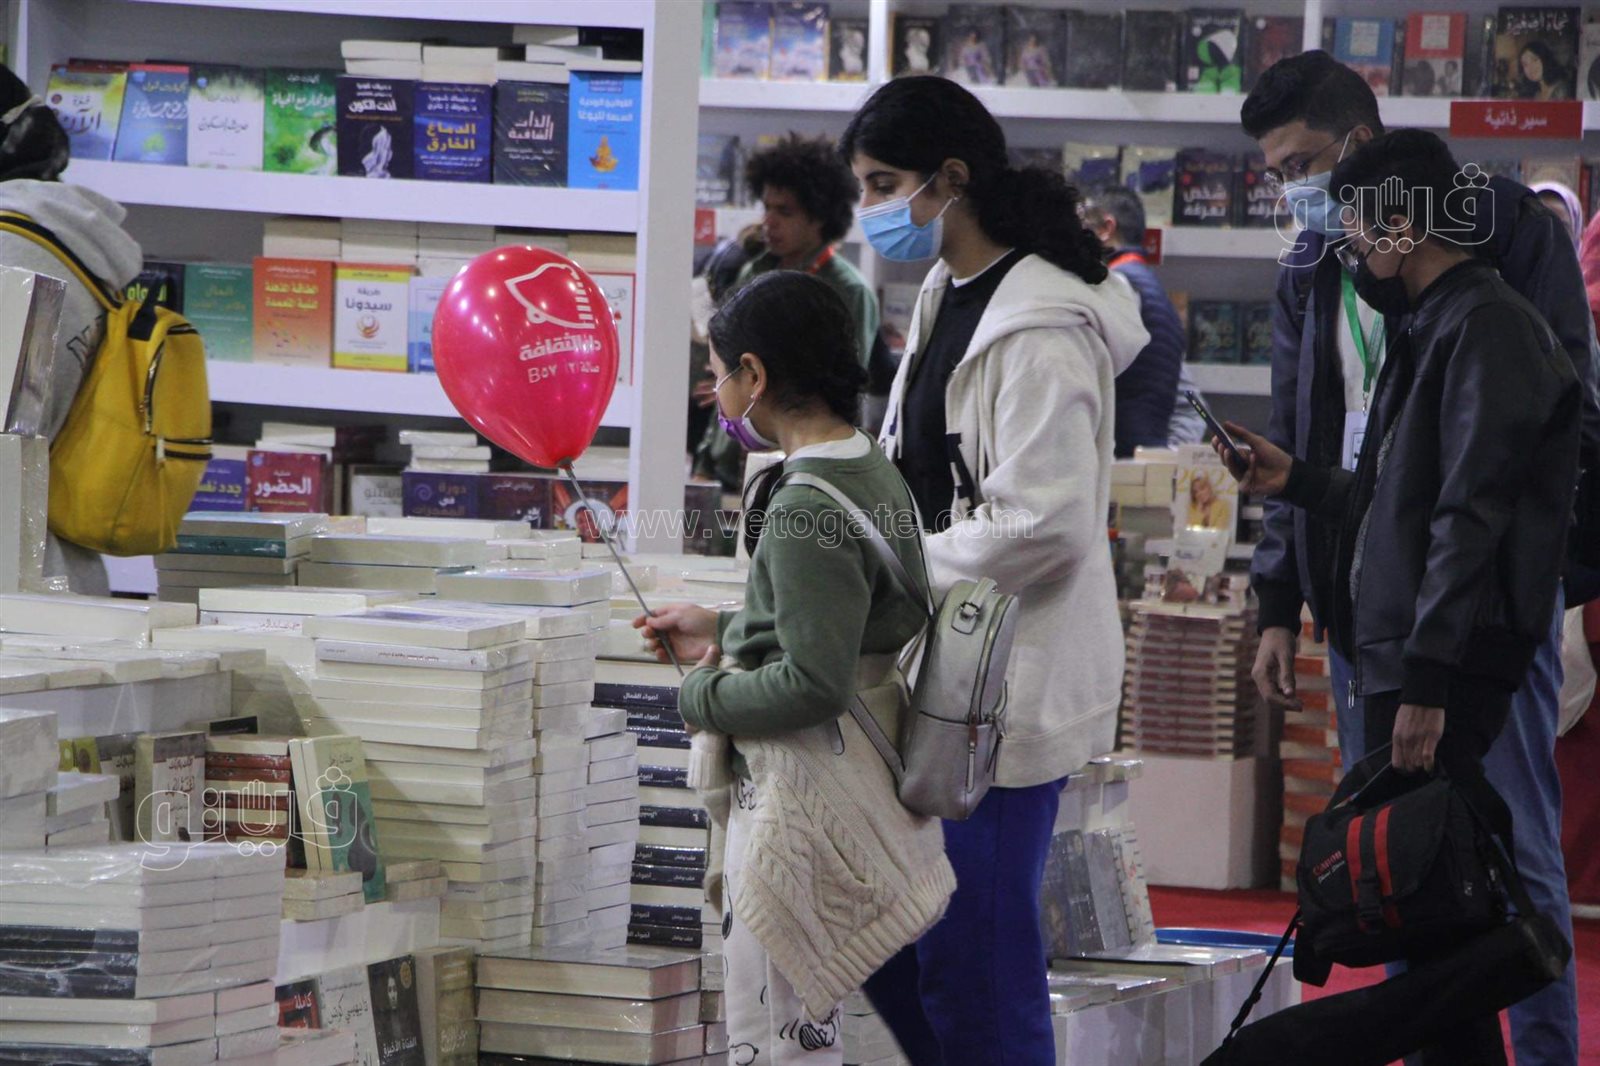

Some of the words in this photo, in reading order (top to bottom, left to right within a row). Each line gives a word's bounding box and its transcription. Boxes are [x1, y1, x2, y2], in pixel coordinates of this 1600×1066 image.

[349, 99, 376, 113] الكون
[377, 99, 397, 112] أنت
[513, 110, 552, 128] الذات
[1519, 115, 1548, 131] سير
[425, 121, 477, 137] الدماغ
[507, 122, 554, 144] الشافية
[425, 137, 476, 151] الخارق
[345, 298, 393, 311] سيدونا
[519, 331, 584, 361] الثقافة
[254, 477, 312, 498] الحضور
[437, 481, 468, 494] دورة
[438, 496, 456, 507] في
